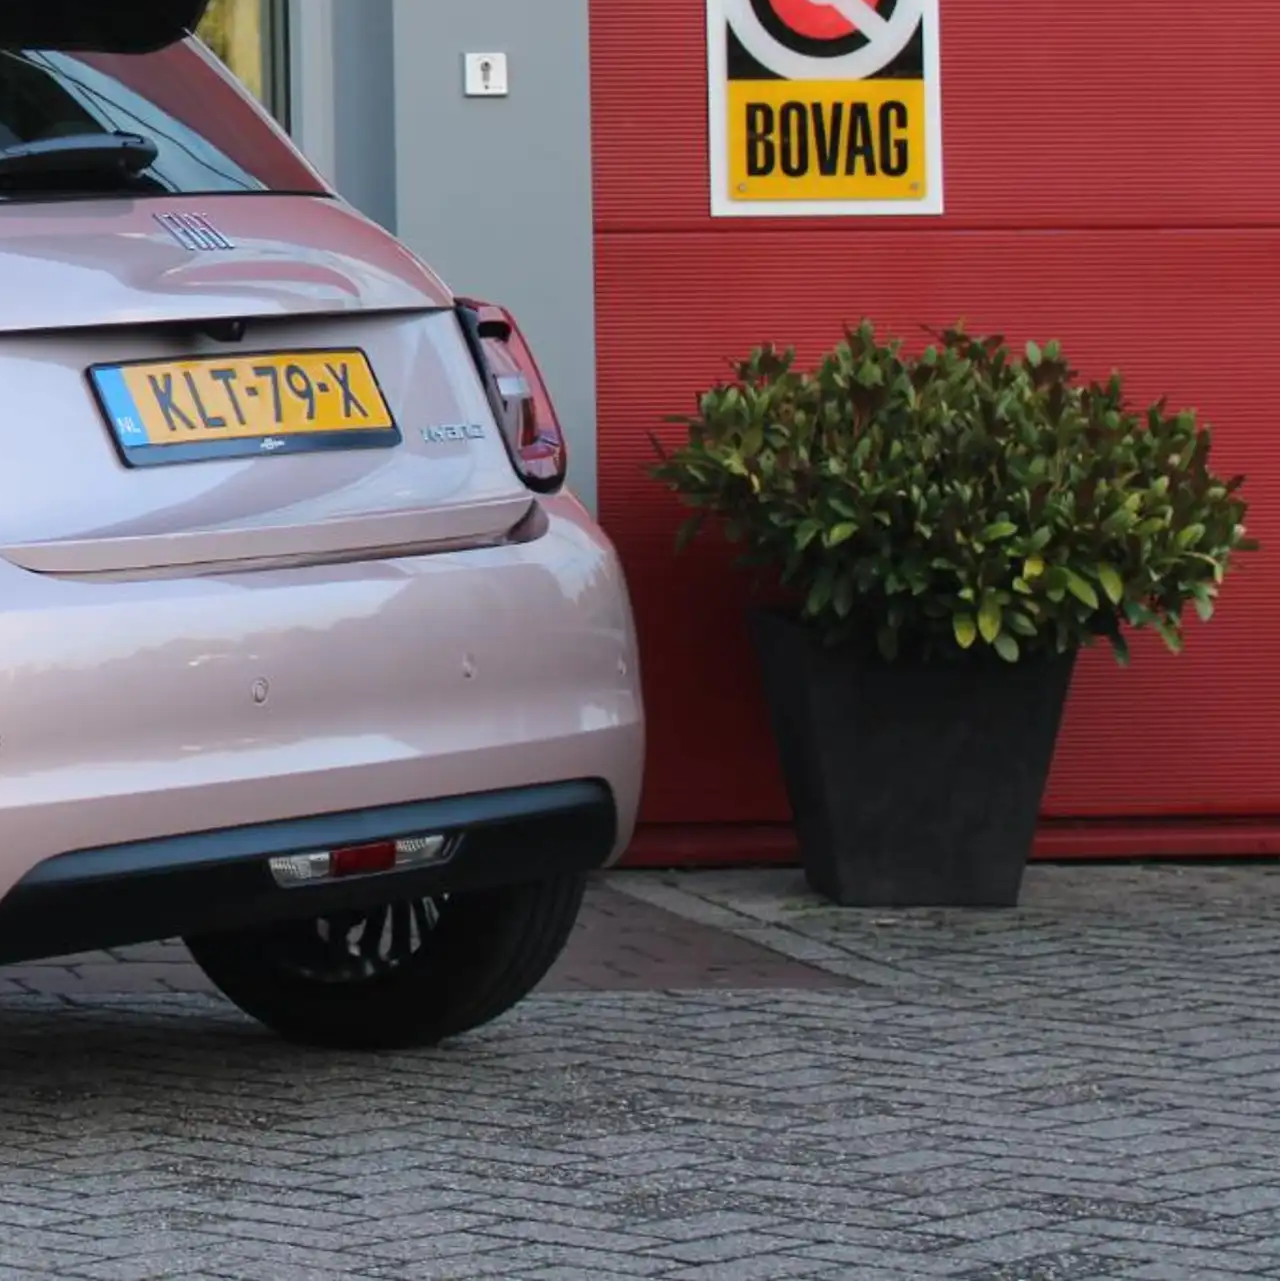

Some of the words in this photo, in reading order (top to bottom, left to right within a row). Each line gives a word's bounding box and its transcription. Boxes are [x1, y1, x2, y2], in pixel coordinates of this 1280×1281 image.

[745, 100, 909, 178] BOVAG
[117, 416, 141, 433] NL
[147, 362, 368, 431] KLT-79-X
